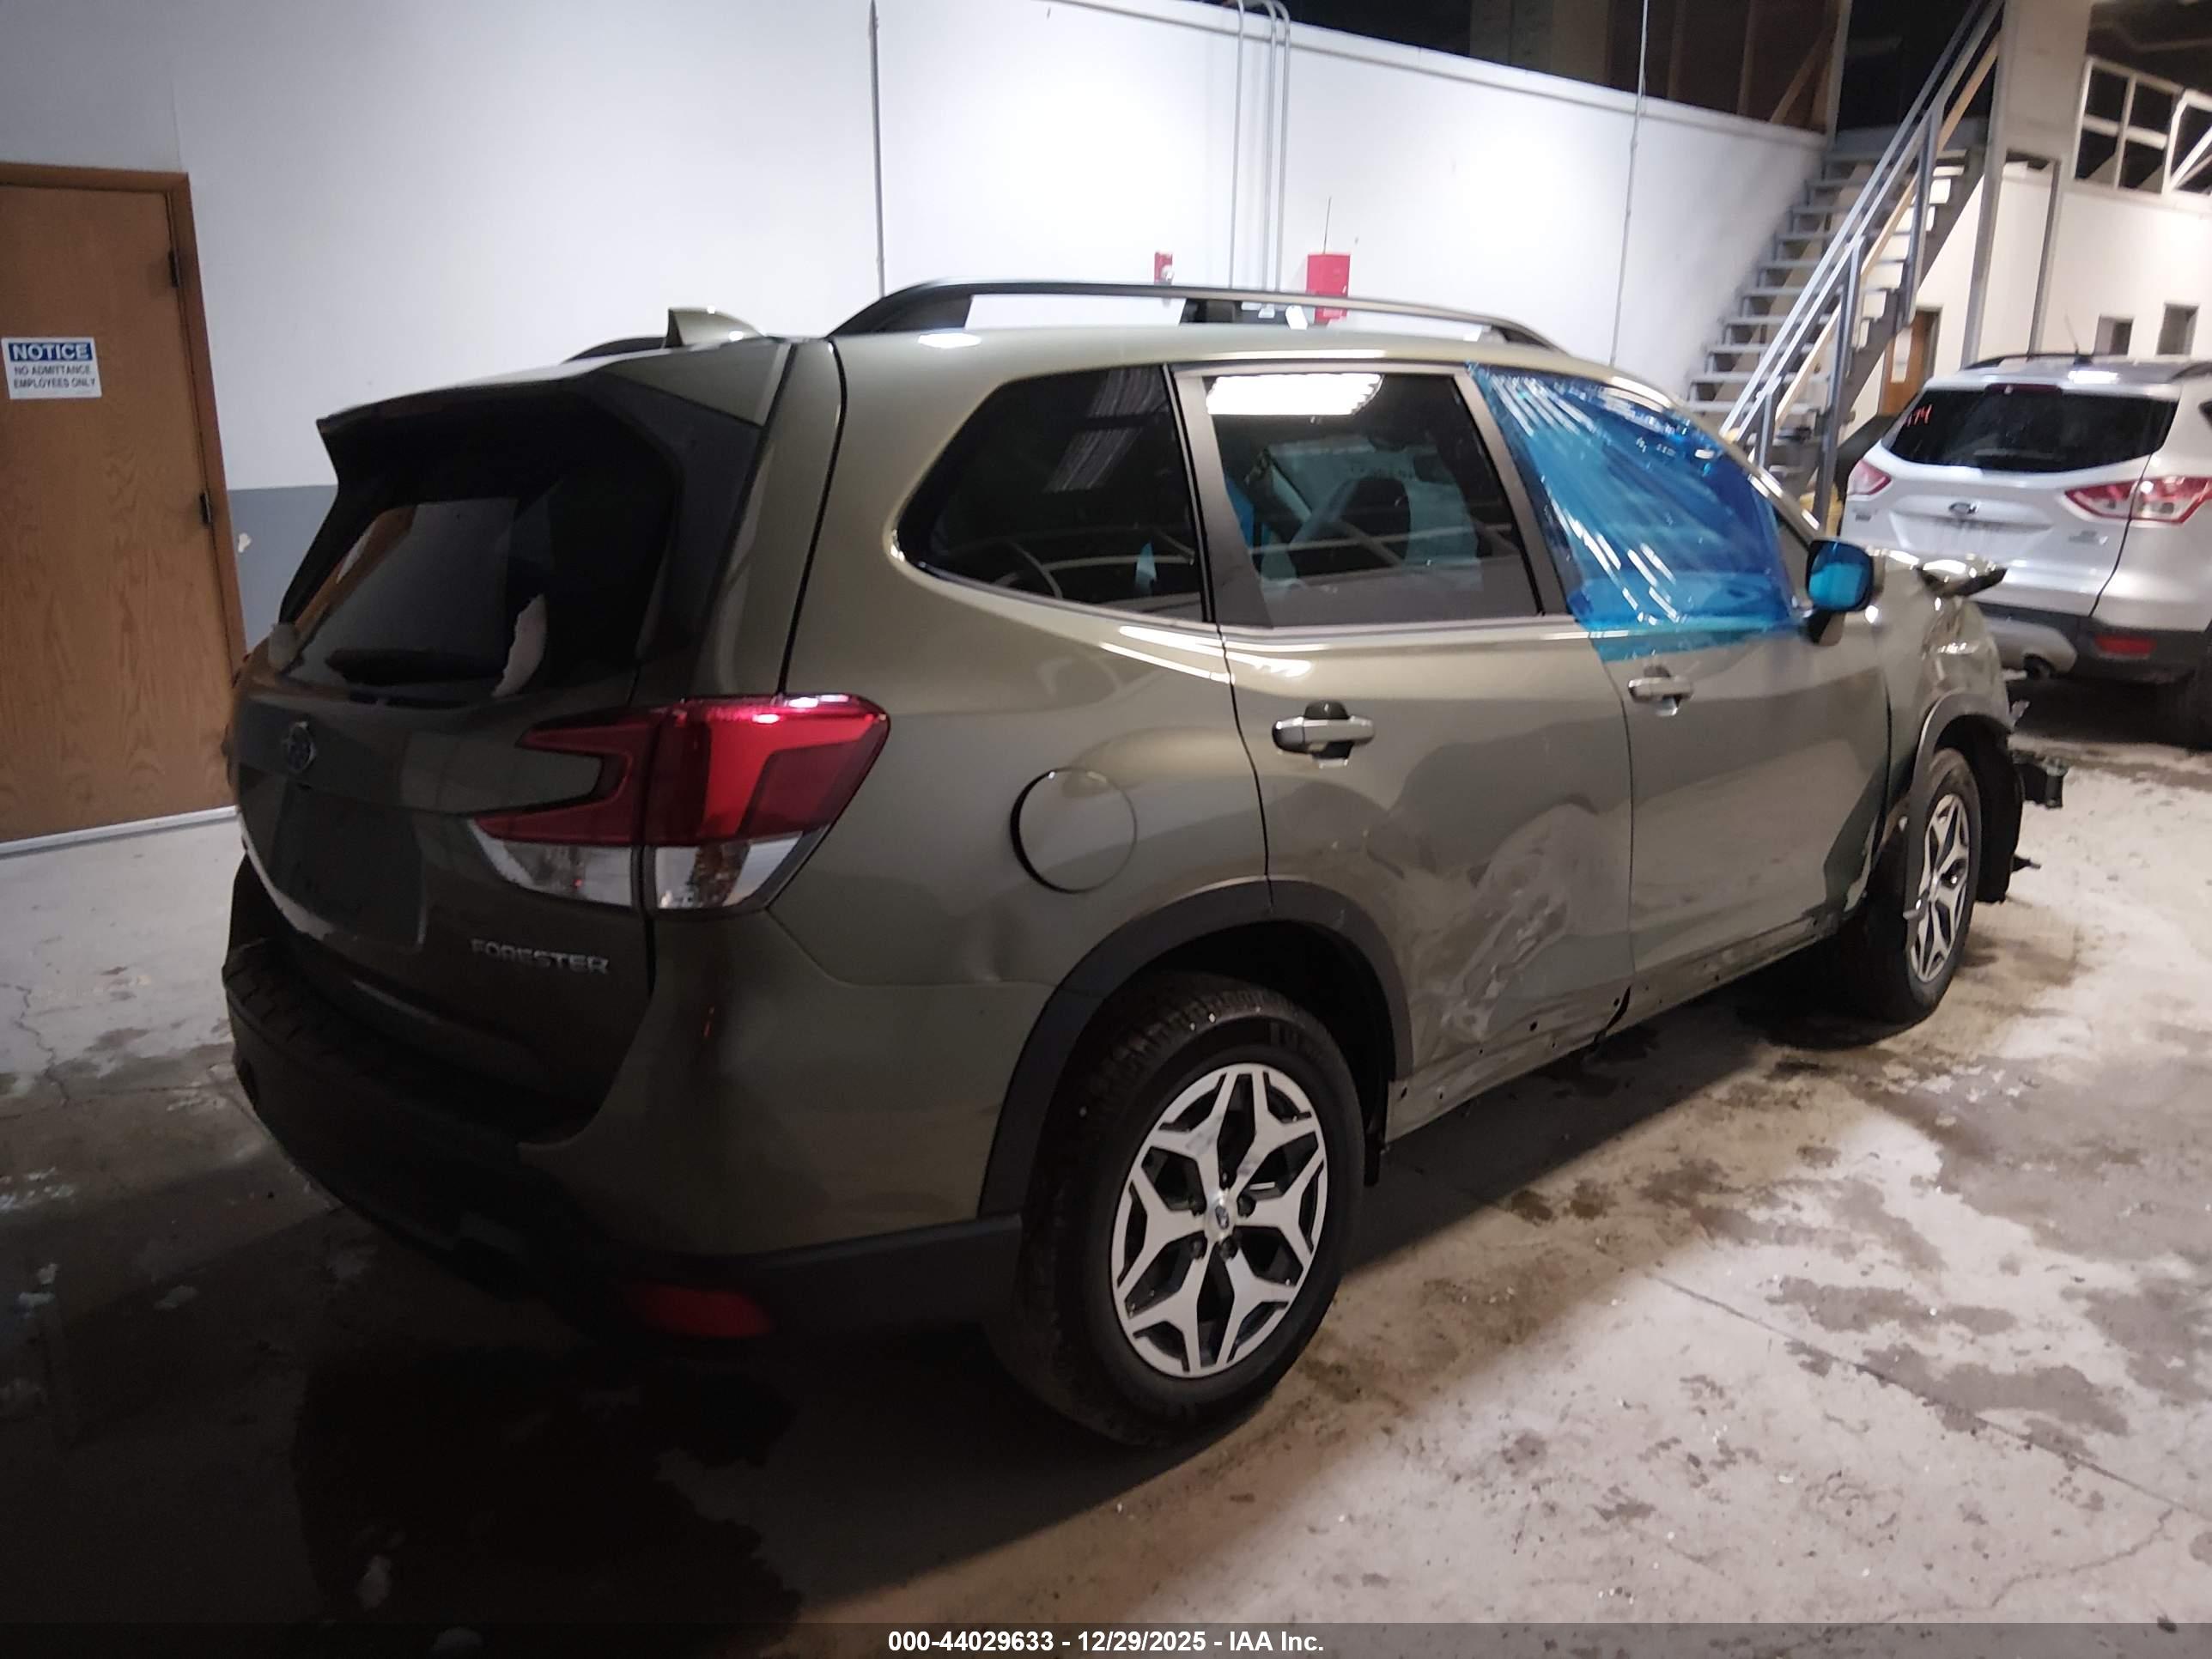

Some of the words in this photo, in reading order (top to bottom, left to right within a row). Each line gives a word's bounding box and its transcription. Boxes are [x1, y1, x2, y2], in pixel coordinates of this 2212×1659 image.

[13, 344, 89, 360] NOTICE
[14, 366, 28, 375] NO
[32, 366, 90, 375] ADMITTANCE
[14, 378, 69, 388] EMPLOYEES
[71, 378, 95, 387] ONLY
[471, 939, 609, 974] FORESTER
